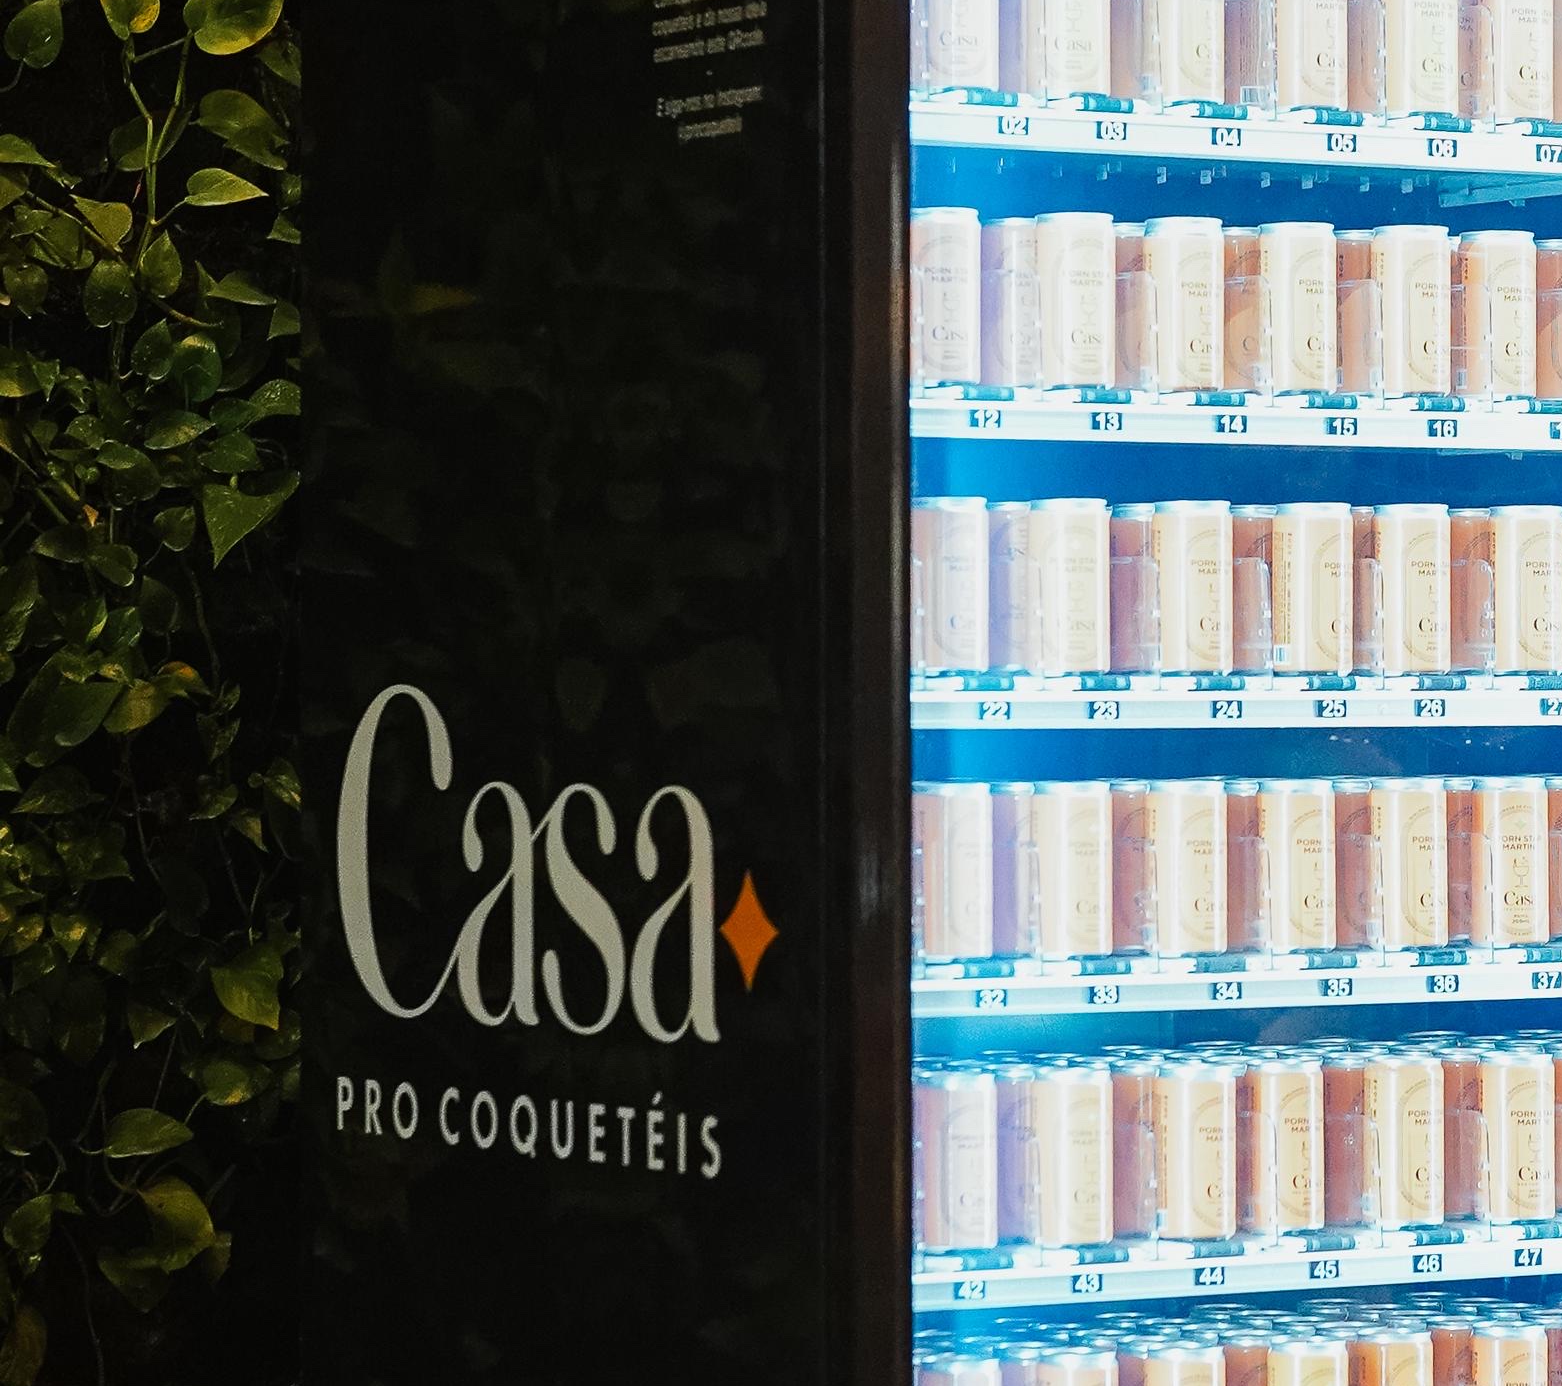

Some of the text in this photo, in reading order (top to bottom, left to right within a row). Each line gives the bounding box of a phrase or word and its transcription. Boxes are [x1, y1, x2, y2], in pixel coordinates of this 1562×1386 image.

[1002, 116, 1027, 135] 02
[1100, 122, 1125, 140] 03
[1215, 128, 1239, 146] 04
[1331, 134, 1355, 152] 05
[1540, 145, 1562, 163] 07
[973, 411, 999, 428] 12
[1095, 413, 1120, 430] 13
[1220, 416, 1246, 433] 14
[1332, 418, 1356, 434] 15
[1433, 421, 1455, 437] 16
[983, 702, 1008, 719] 22
[1093, 701, 1117, 718] 23
[1215, 701, 1240, 718] 24
[1321, 700, 1346, 717] 25
[1420, 699, 1443, 716] 26
[337, 684, 721, 1043] Casa
[1327, 979, 1350, 996] 35
[1433, 975, 1456, 992] 36
[1538, 972, 1560, 989] 37
[979, 990, 1005, 1007] 32
[1093, 986, 1117, 1003] 33
[1215, 983, 1240, 999] 34
[337, 1076, 722, 1179] PRO COQUETÉIS
[1417, 1256, 1440, 1272] 46
[1519, 1249, 1540, 1266] 47
[1199, 1268, 1223, 1285] 44
[1313, 1262, 1338, 1279] 45
[1075, 1275, 1100, 1293] 43
